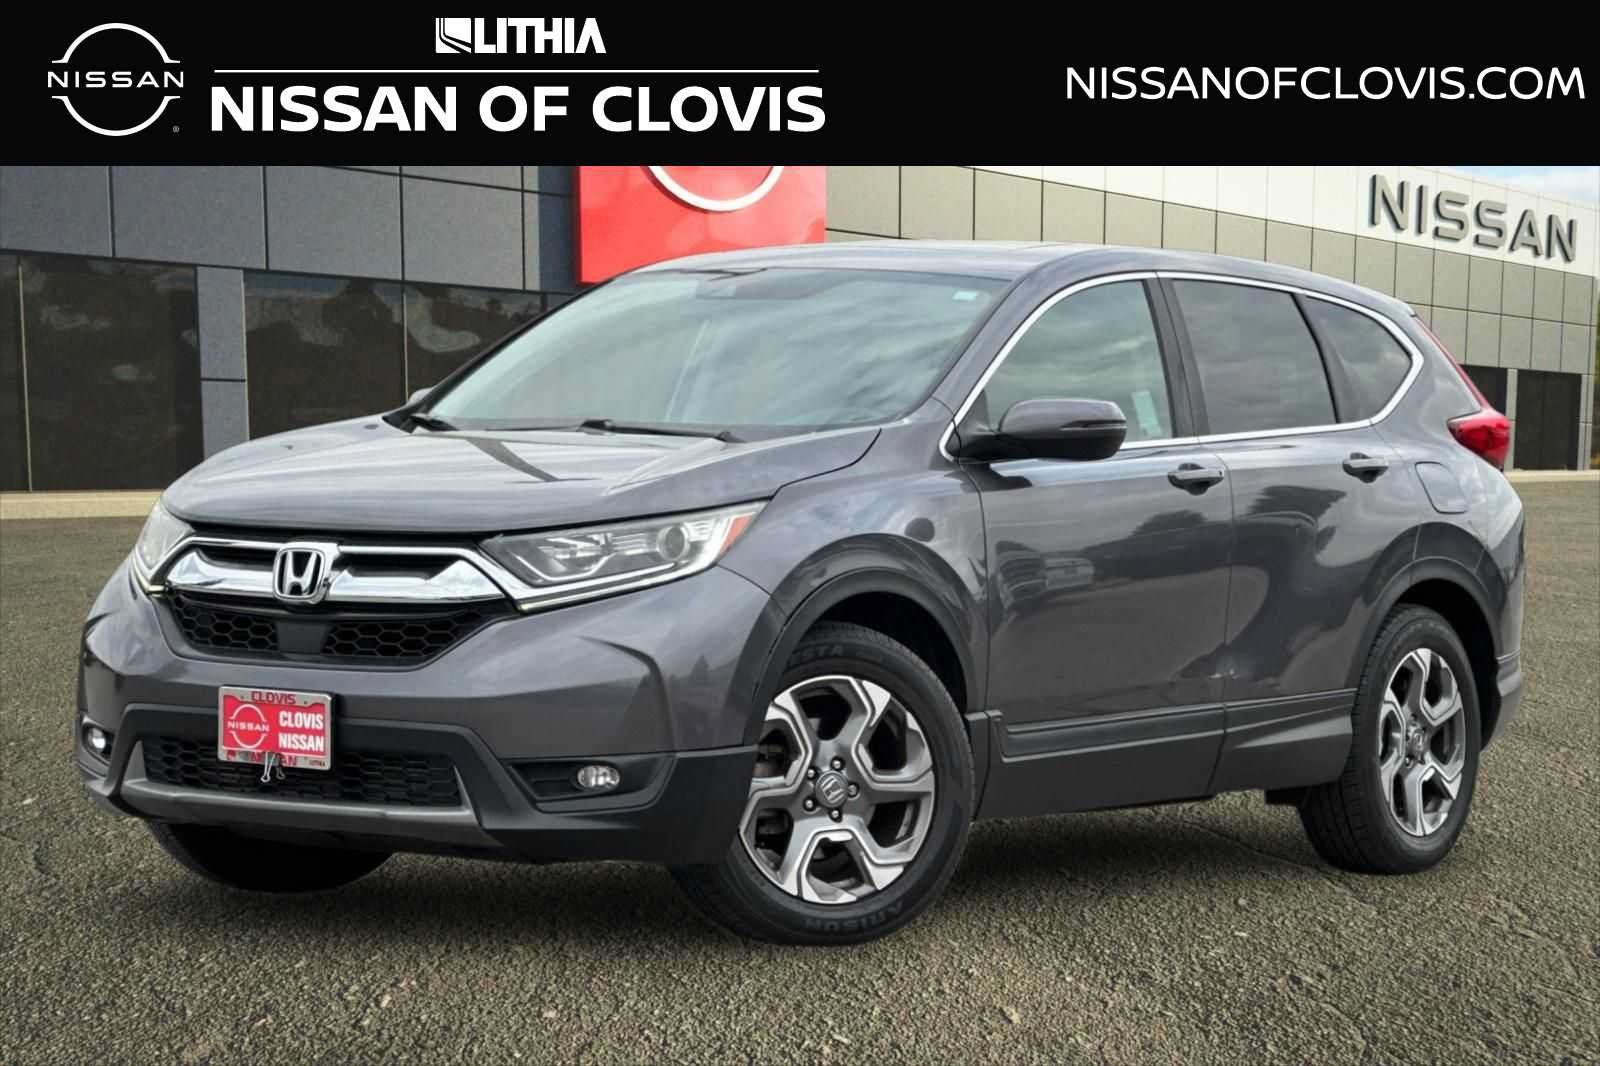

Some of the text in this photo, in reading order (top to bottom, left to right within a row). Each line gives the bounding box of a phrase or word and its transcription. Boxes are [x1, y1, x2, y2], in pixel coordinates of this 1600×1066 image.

[1369, 174, 1577, 262] NISSAN
[251, 691, 296, 705] CLOVIS
[227, 720, 270, 732] NISSAN
[279, 711, 324, 730] CLOVIS
[278, 732, 324, 752] NISSAN
